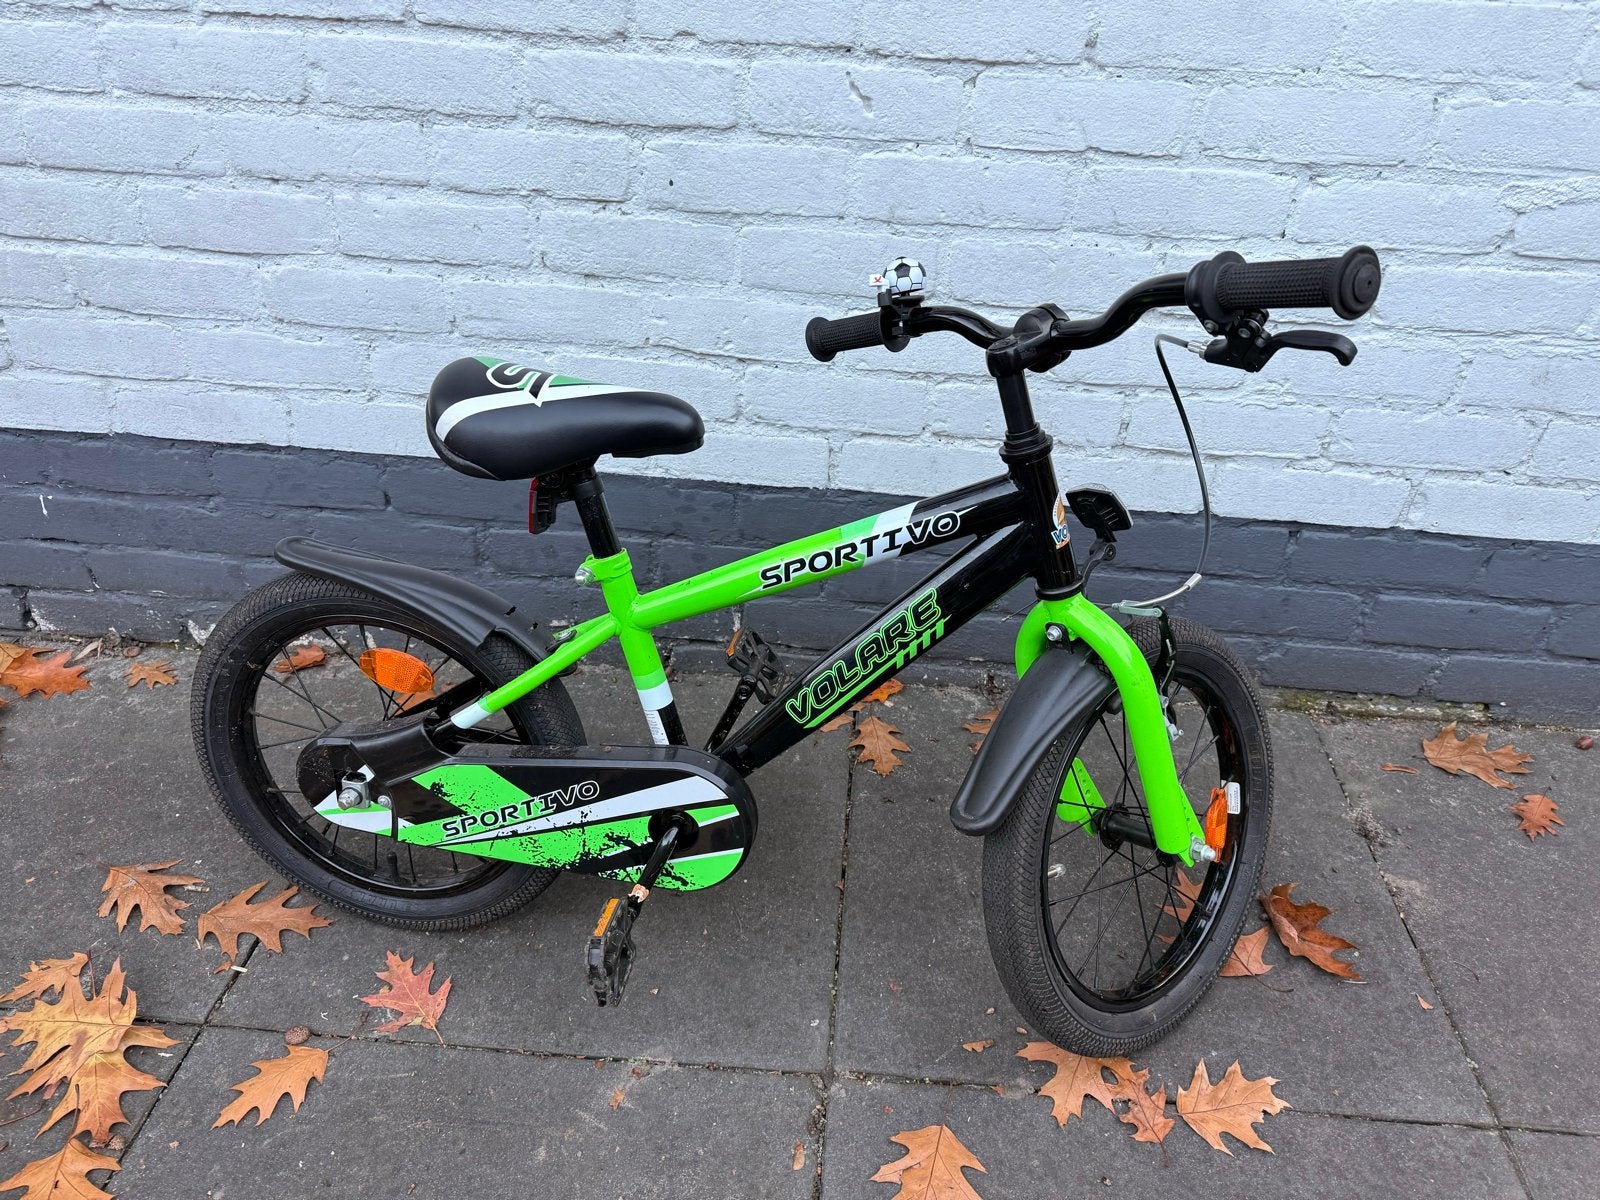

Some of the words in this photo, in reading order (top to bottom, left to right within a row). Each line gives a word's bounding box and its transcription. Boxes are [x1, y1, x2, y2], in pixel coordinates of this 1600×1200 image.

[760, 510, 960, 590] SPORTIVO
[785, 587, 942, 724] VOLARE
[441, 780, 600, 838] SPORTIVO
